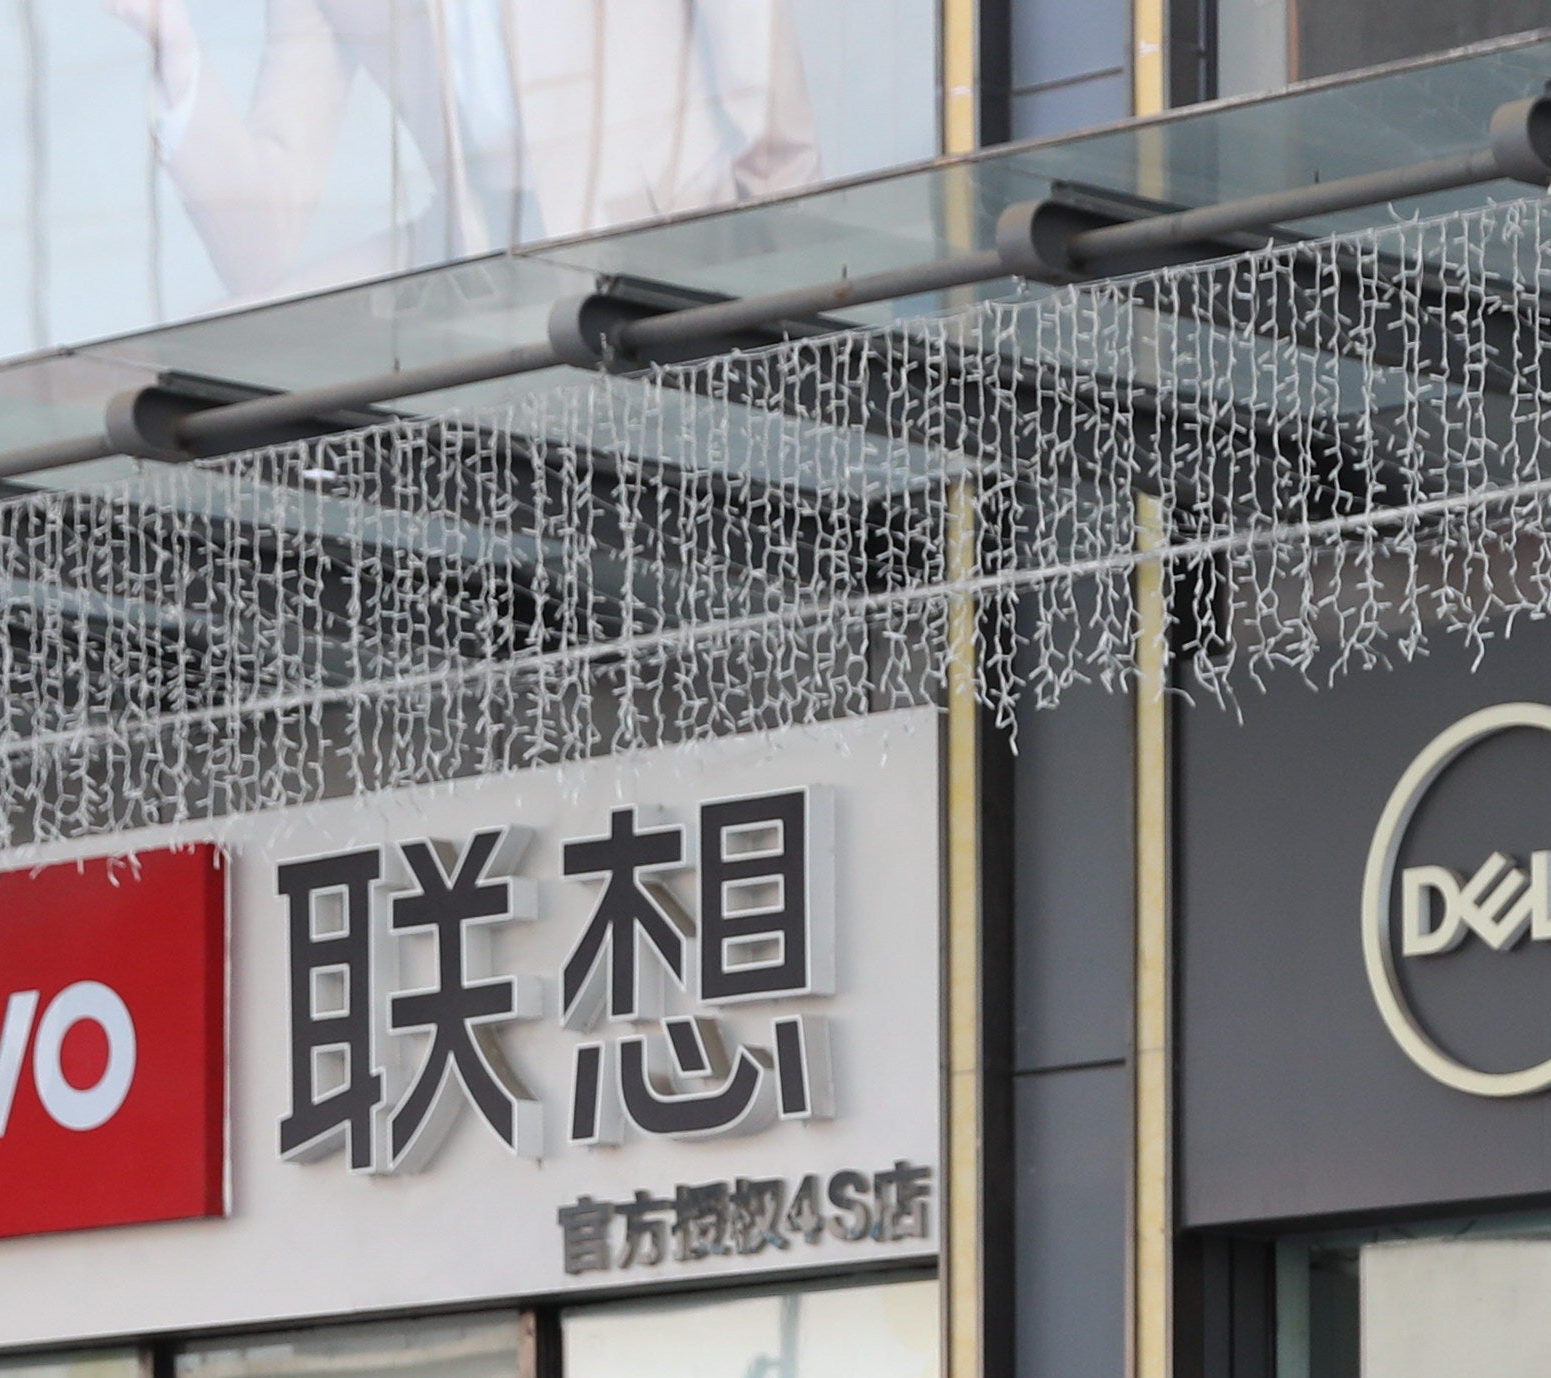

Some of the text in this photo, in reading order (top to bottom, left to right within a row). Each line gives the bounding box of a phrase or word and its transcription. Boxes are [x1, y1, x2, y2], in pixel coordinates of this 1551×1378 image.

[275, 786, 837, 1177] 联想
[557, 1159, 932, 1275] 官方授权4S店
